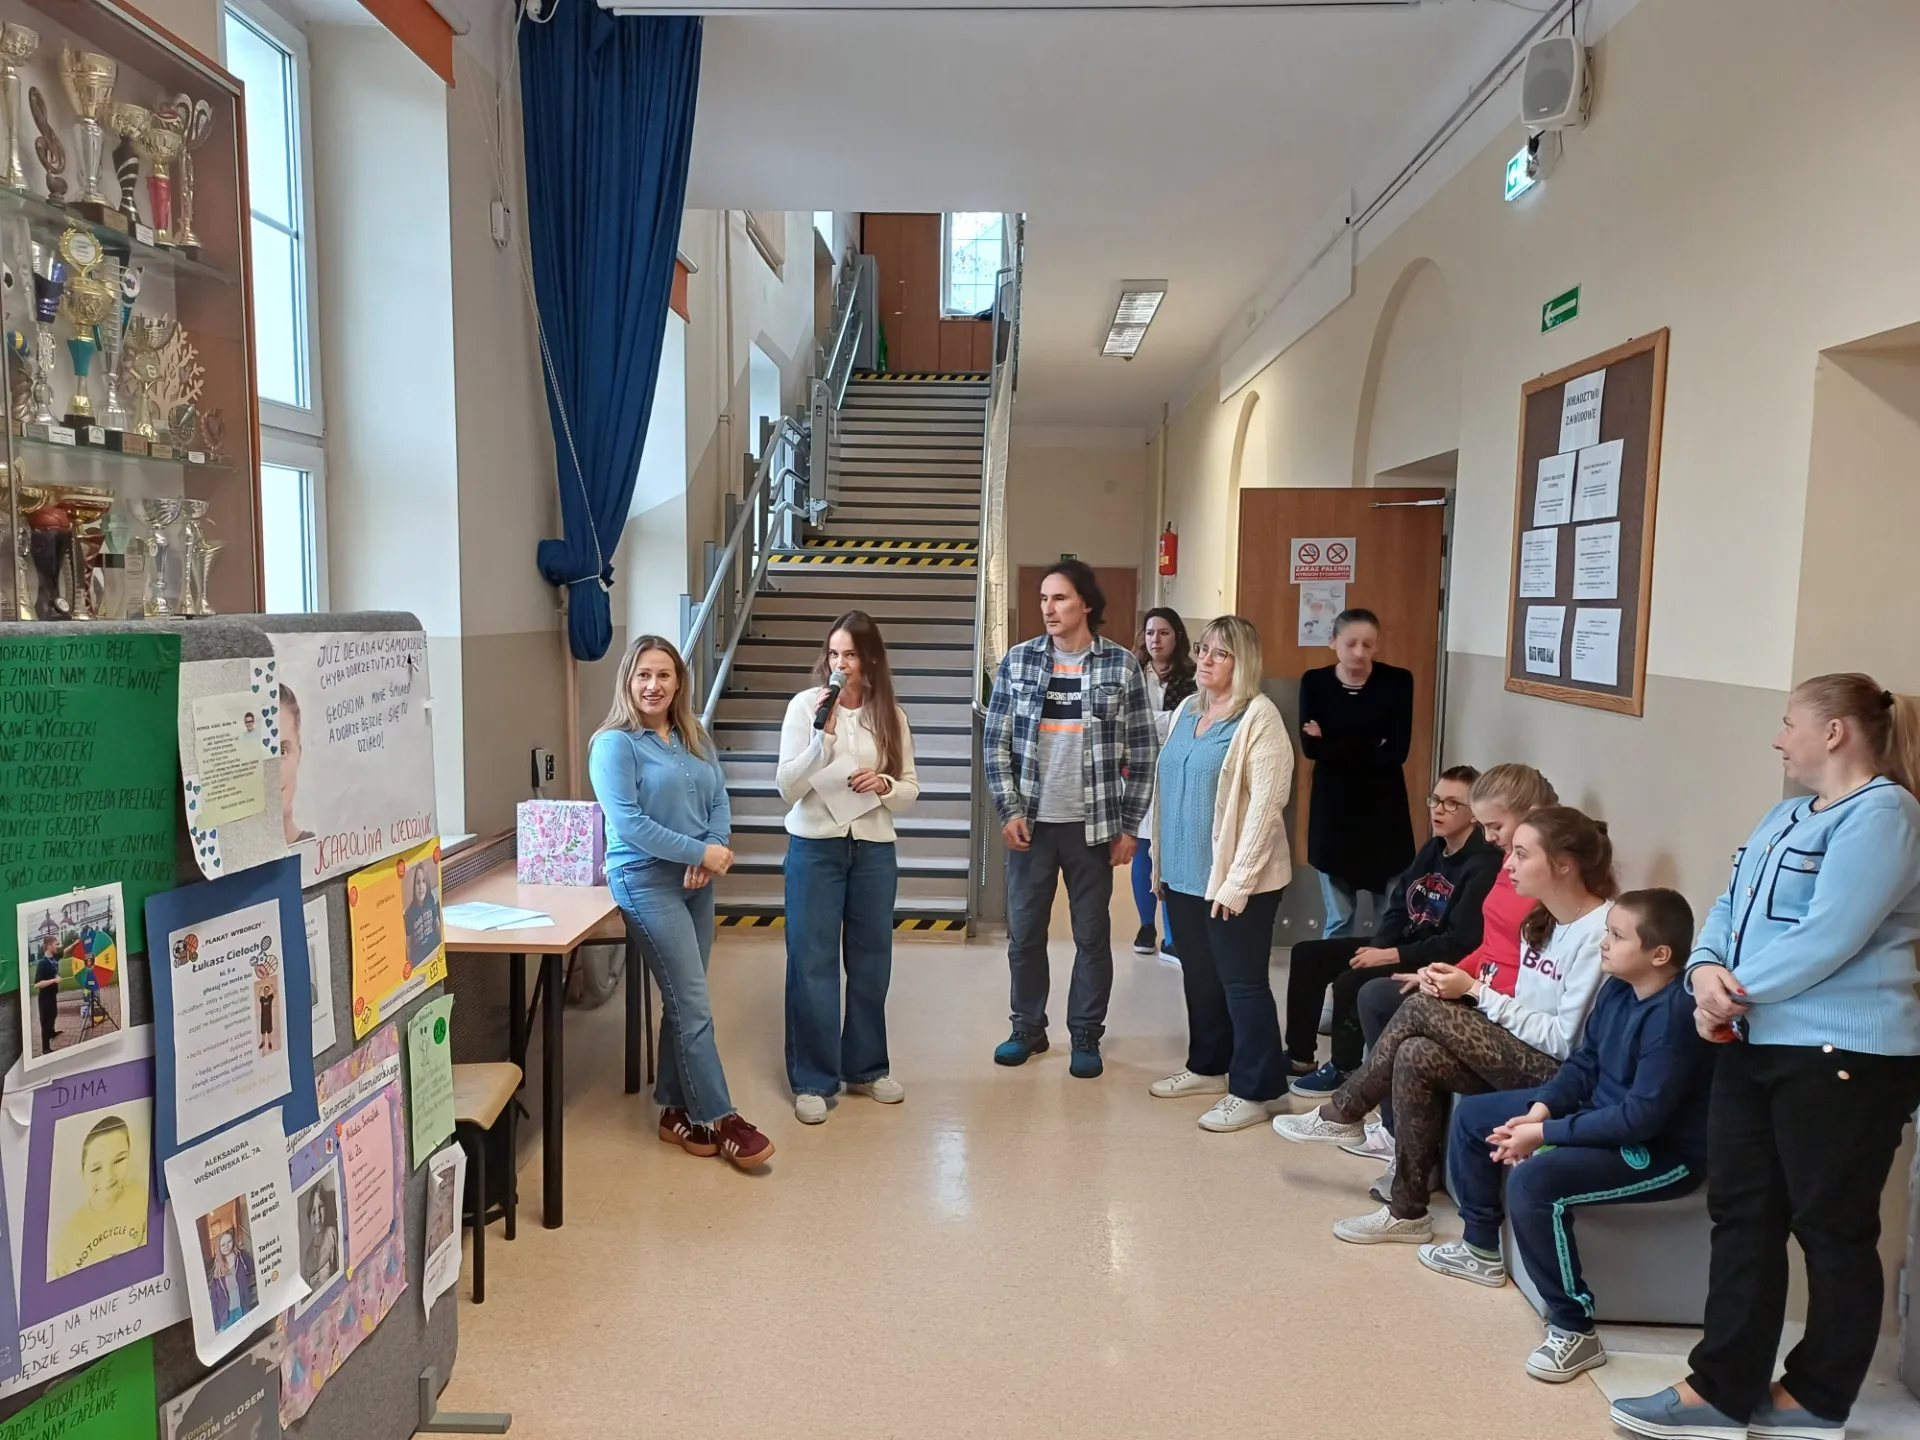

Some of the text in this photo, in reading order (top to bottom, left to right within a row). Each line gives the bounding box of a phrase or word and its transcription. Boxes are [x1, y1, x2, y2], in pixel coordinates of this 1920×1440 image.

[106, 640, 136, 663] BĘDĘ
[317, 641, 340, 668] JUŻ
[343, 641, 376, 661] DEKADA
[10, 666, 55, 687] ZMIANY
[60, 665, 87, 685] NAM
[93, 666, 168, 696] ZAPEWNIĘ
[36, 717, 97, 740] WYCIECZKI
[22, 740, 94, 763] DYSKOTEKI
[15, 764, 85, 791] PORZĄDEK
[20, 792, 61, 816] BĘDZIE
[45, 814, 102, 840] GRZĄDEK
[37, 864, 69, 883] GŁOS
[192, 943, 261, 973] Łukasz Cieloch
[202, 983, 220, 996] głosuj
[221, 979, 228, 987] na
[228, 975, 243, 985] mnie
[51, 1078, 108, 1109] DIMA
[193, 1146, 261, 1186] WIŚNIEWSKA KL. 7A
[204, 1140, 249, 1168] ALEKSANDRA
[259, 1181, 274, 1193] mnę
[251, 1191, 276, 1211] nuda Ci
[250, 1212, 261, 1223] nie
[75, 1225, 127, 1269] MOTORCYCLE
[258, 1238, 276, 1253] Tańcz
[258, 1244, 283, 1266] śpiewaj
[260, 1257, 282, 1276] tak jak
[264, 1277, 272, 1288] ja
[64, 1314, 82, 1334] NA
[89, 1297, 121, 1322] MNIE
[69, 1339, 90, 1361] SIĘ
[97, 1318, 142, 1350] DZIAŁO
[223, 1387, 266, 1426] GŁOSEM
